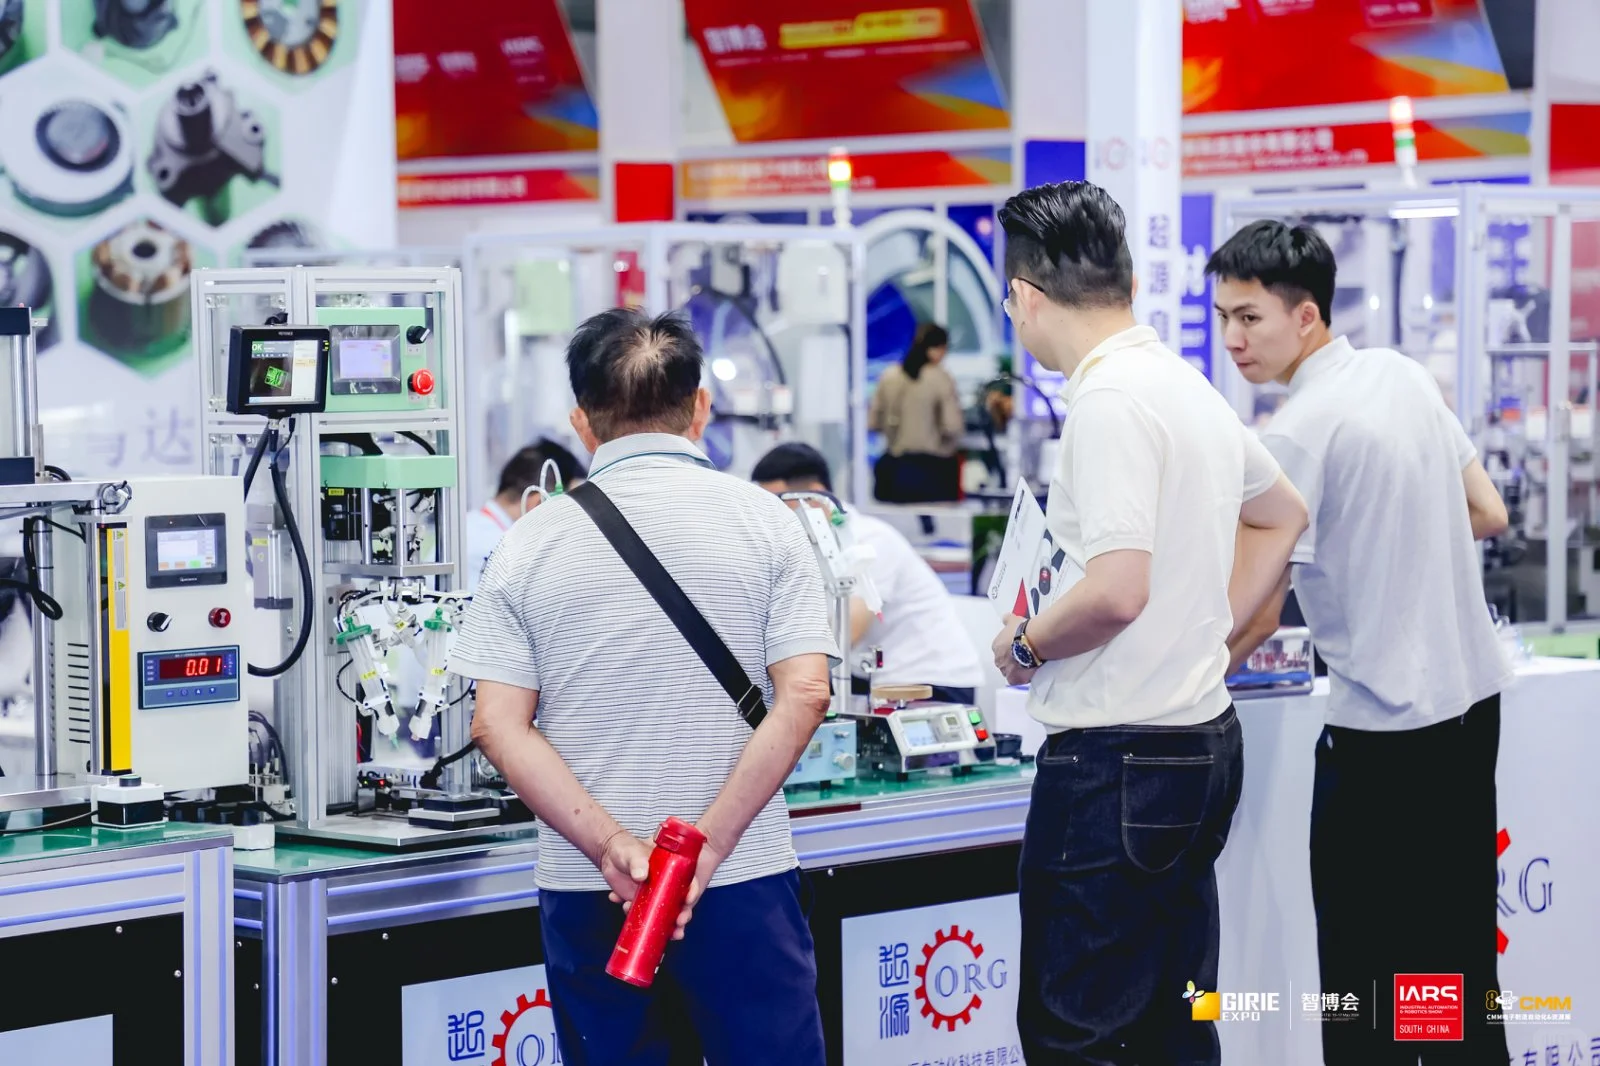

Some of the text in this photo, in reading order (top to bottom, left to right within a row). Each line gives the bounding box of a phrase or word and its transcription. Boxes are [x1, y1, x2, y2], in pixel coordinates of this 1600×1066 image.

[252, 343, 263, 352] OK
[186, 657, 222, 677] 0.01
[934, 958, 1008, 998] ORG
